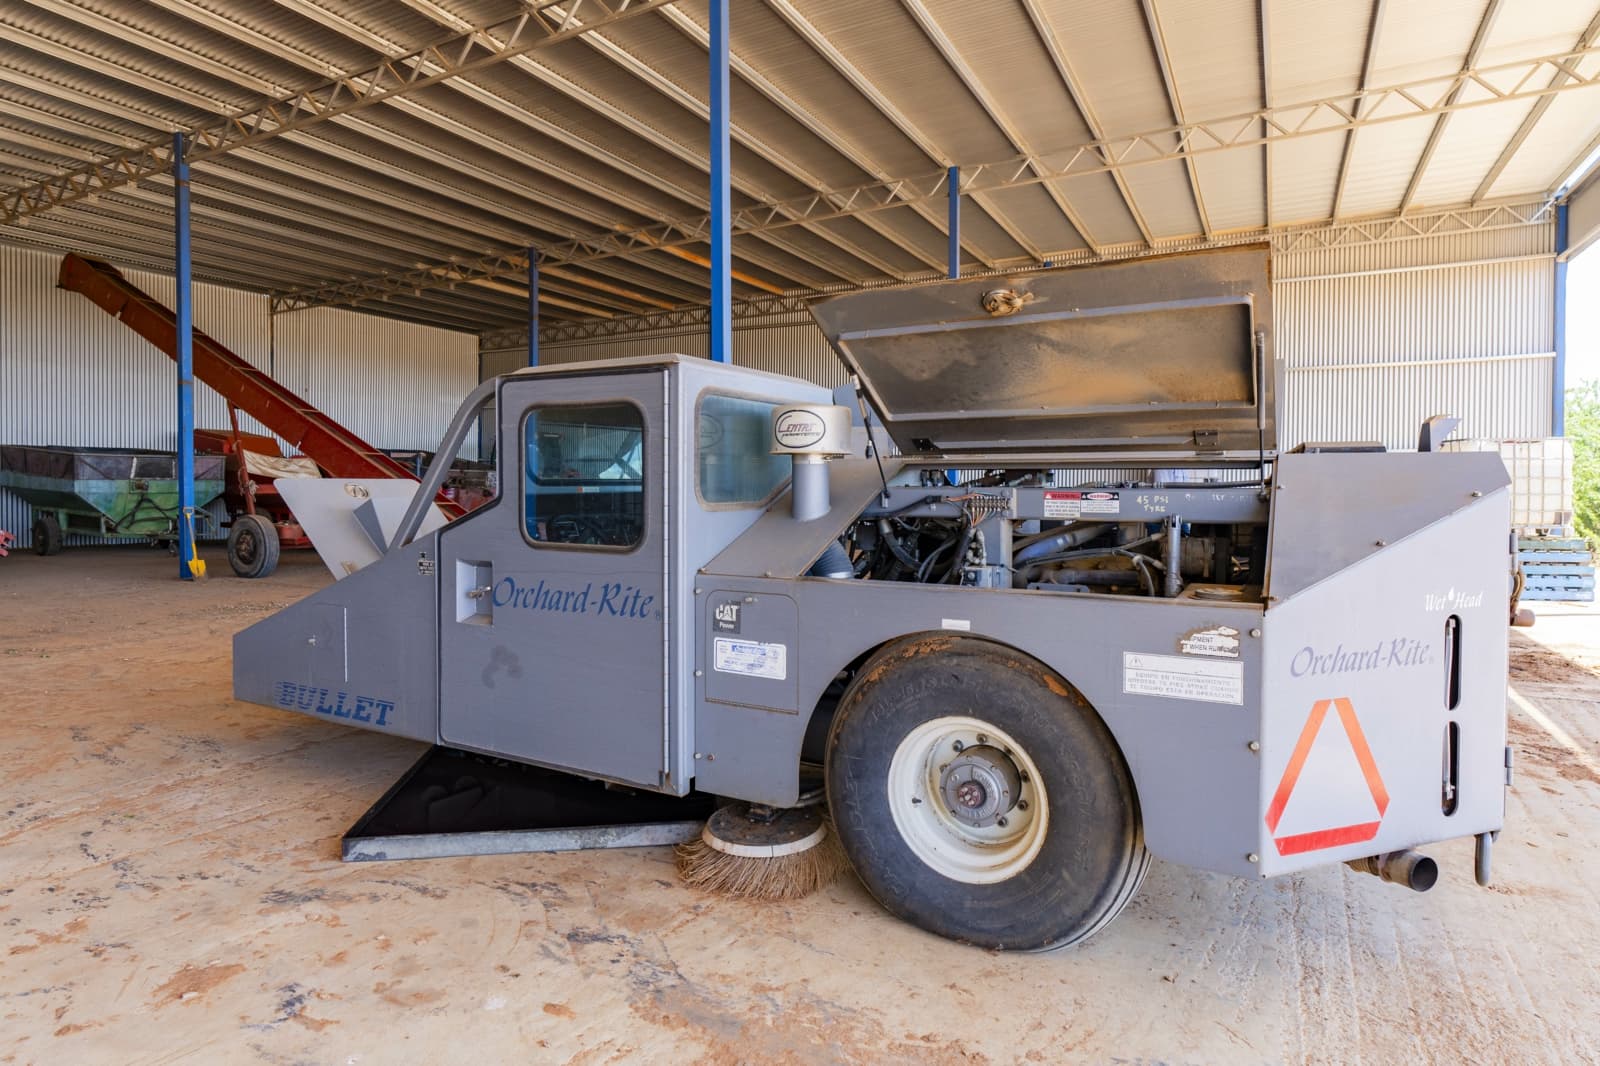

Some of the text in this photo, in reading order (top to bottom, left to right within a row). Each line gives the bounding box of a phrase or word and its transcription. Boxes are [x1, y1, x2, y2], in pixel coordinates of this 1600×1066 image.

[1136, 496, 1149, 505] 45
[492, 576, 654, 619] Orchard-Rite
[1425, 592, 1483, 611] Wet Head
[715, 604, 740, 622] CAT
[1290, 637, 1430, 678] Orchard-Rite
[274, 681, 395, 726] BULLET
